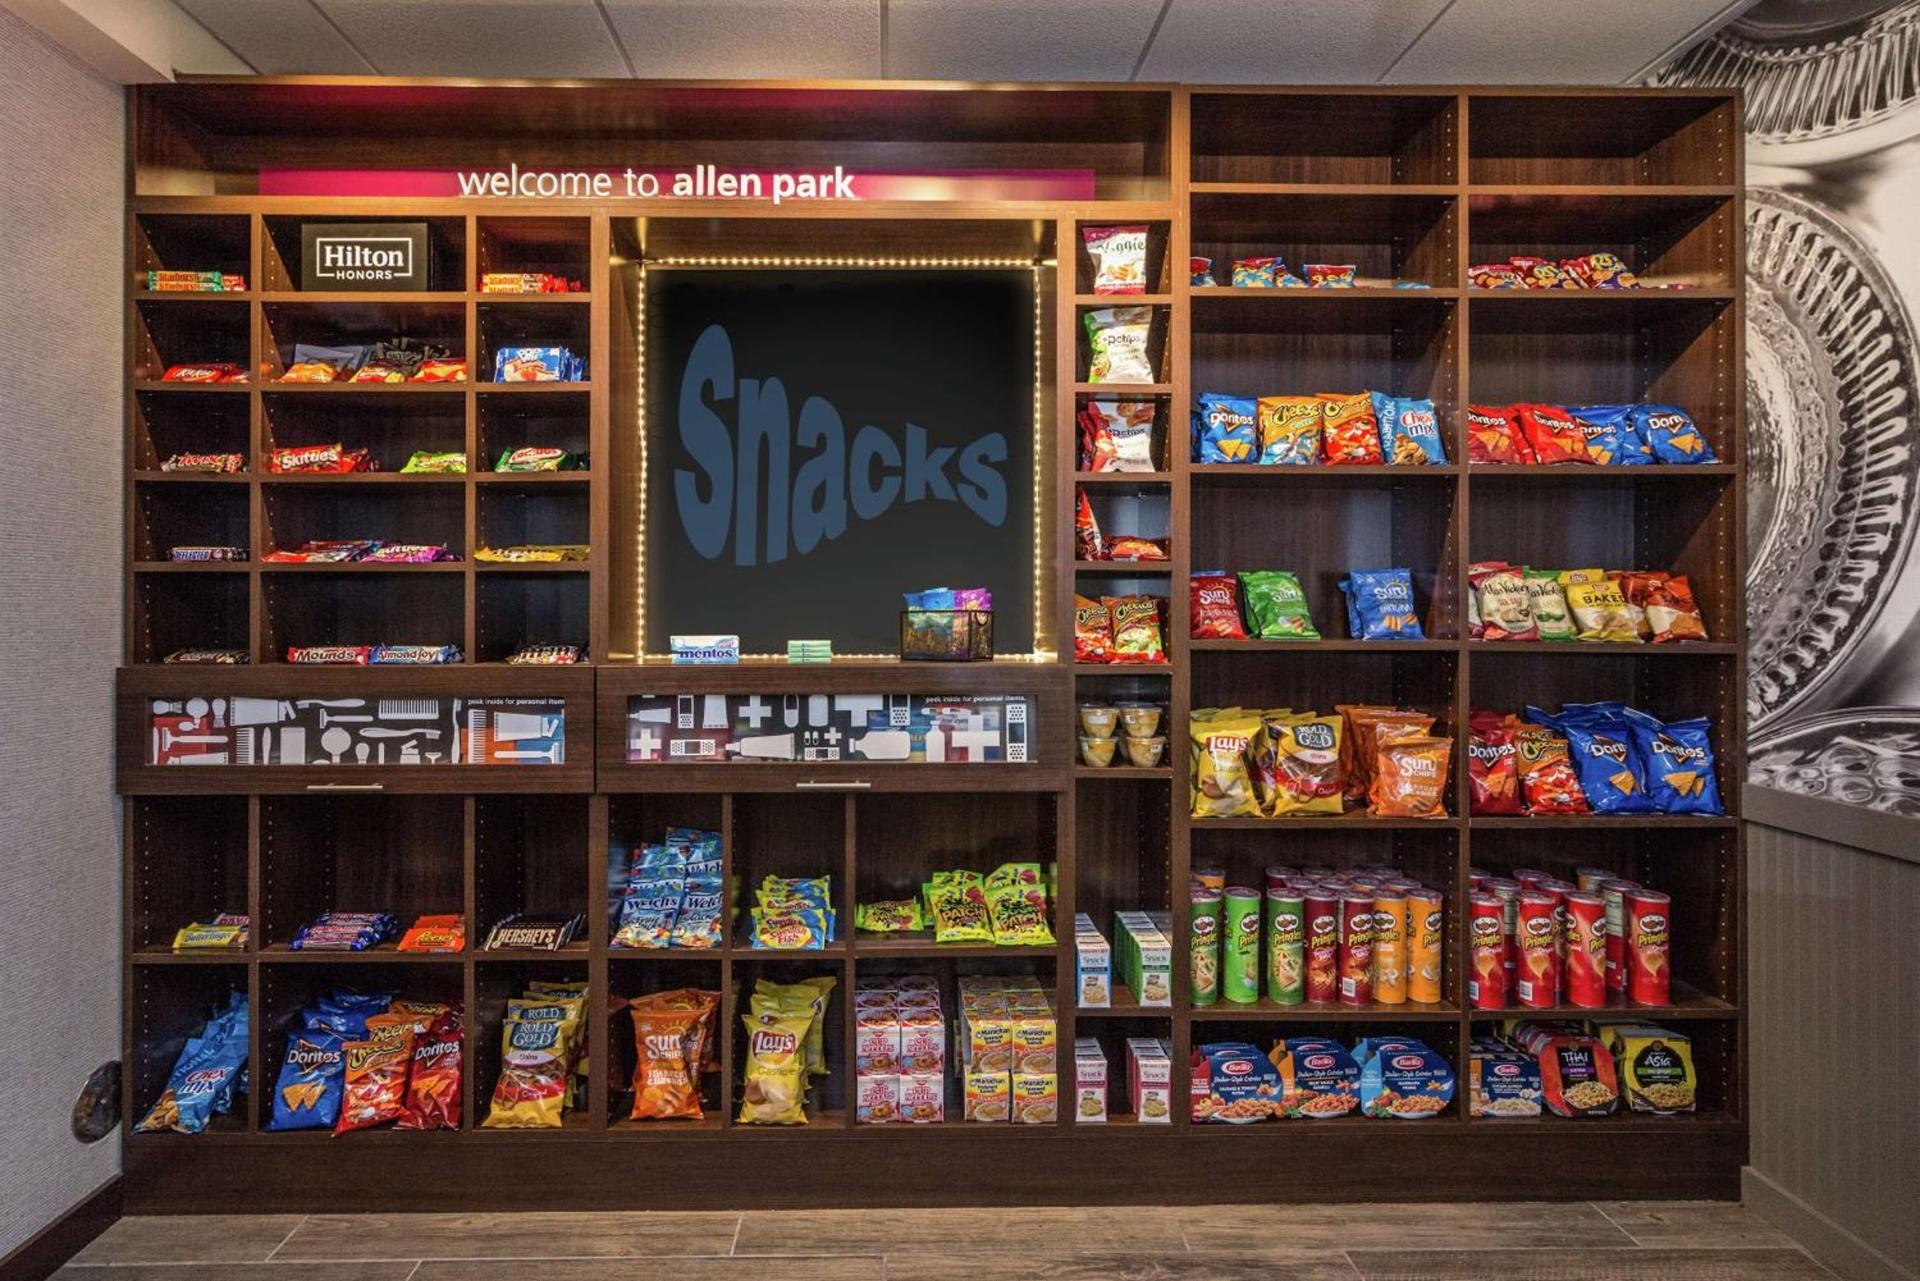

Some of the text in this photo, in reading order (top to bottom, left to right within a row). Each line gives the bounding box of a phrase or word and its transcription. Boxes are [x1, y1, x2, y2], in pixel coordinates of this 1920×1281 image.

[459, 163, 857, 204] welcome to allen park
[324, 245, 404, 268] Hilton
[336, 269, 393, 280] HONORS
[1210, 412, 1254, 427] Doritos
[673, 323, 1008, 567] Snacks
[281, 447, 337, 469] Skittles
[1200, 588, 1230, 604] Sun
[1375, 586, 1407, 600] Sun
[297, 650, 355, 663] Mounds
[378, 649, 436, 664] Almond Joy
[679, 647, 734, 659] mentos
[1209, 735, 1248, 752] Lay's
[1299, 733, 1332, 747] GOLD
[1469, 743, 1516, 758] Doritos
[1651, 741, 1705, 758] Doritos
[1400, 757, 1432, 777] Sun
[941, 908, 984, 921] PATCH
[1000, 914, 1042, 931] PATCH
[495, 927, 556, 947] HERSHEY'S
[1144, 954, 1167, 963] Snack
[528, 1007, 560, 1019] ROLD
[520, 1022, 553, 1032] ROLD
[513, 1032, 552, 1046] GOLD
[754, 1031, 794, 1054] Lay's
[416, 1040, 460, 1060] Doritos
[645, 1035, 681, 1059] Sun
[288, 1049, 341, 1064] Doritos
[1561, 1051, 1589, 1063] THAI
[1644, 1055, 1672, 1067] Asia
[1143, 1070, 1166, 1078] Snack
